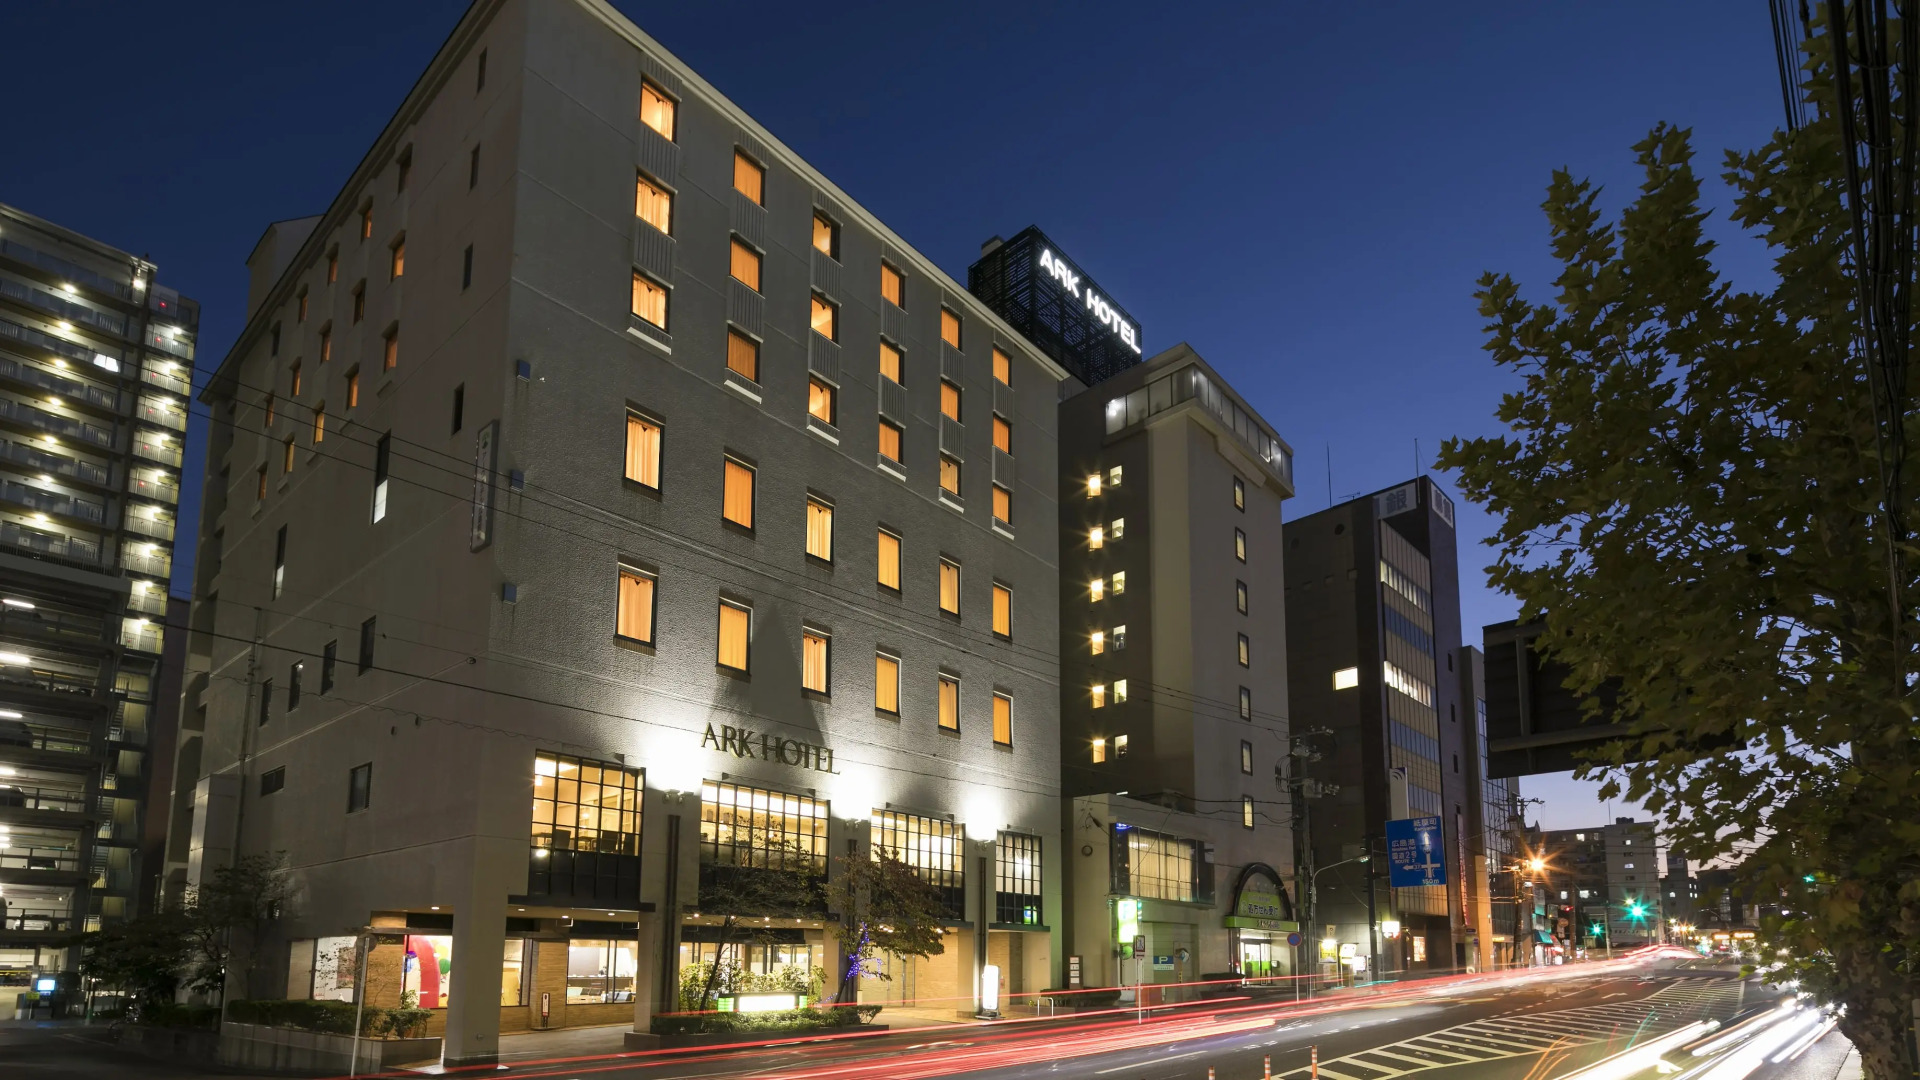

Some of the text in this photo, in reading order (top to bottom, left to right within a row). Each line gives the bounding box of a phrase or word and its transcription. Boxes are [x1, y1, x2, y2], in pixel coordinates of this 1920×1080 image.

[1040, 249, 1141, 354] ARK HOTEL
[701, 722, 840, 775] ARK HOTEL
[1392, 838, 1415, 847] 広島港
[1159, 956, 1168, 964] P
